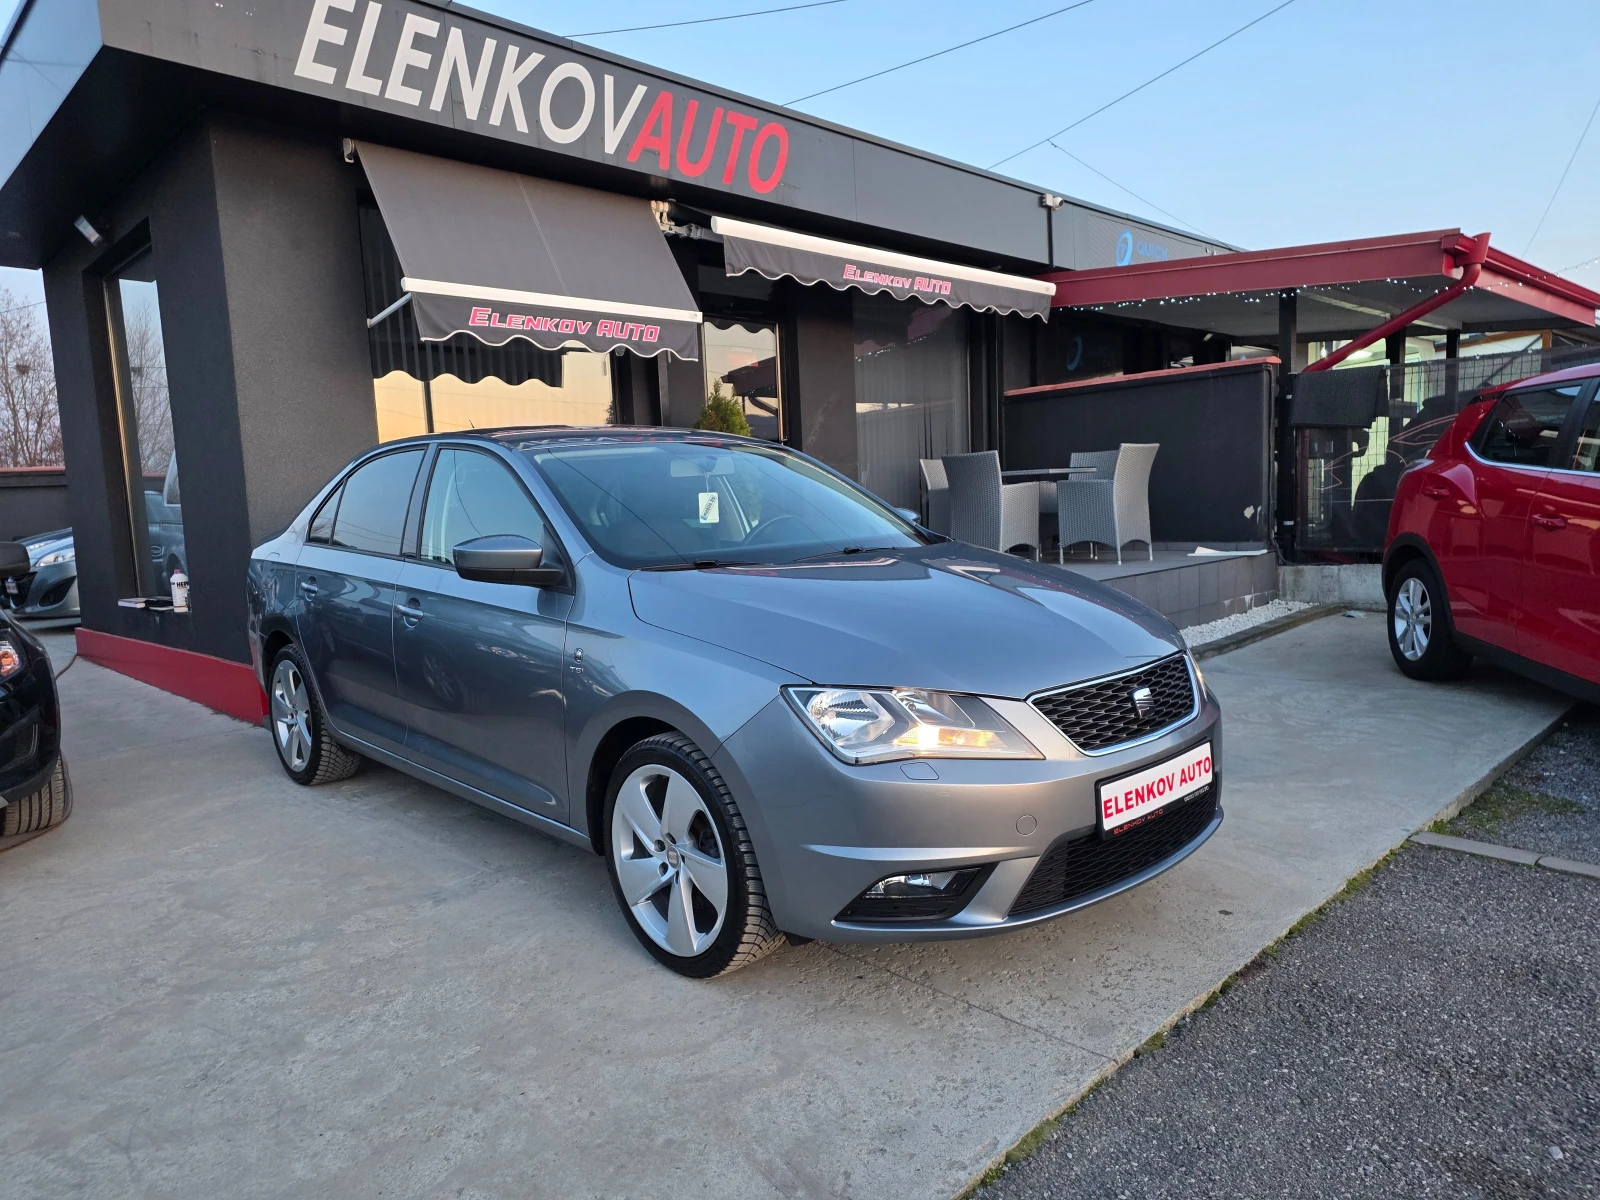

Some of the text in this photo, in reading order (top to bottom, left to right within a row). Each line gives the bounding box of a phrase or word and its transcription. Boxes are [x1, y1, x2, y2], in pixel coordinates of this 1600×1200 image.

[843, 264, 952, 295] ELENKOV AUTO
[468, 306, 661, 343] ELENKOV AUTO
[1103, 772, 1175, 820] ELENKOV
[1179, 756, 1212, 787] AUTO
